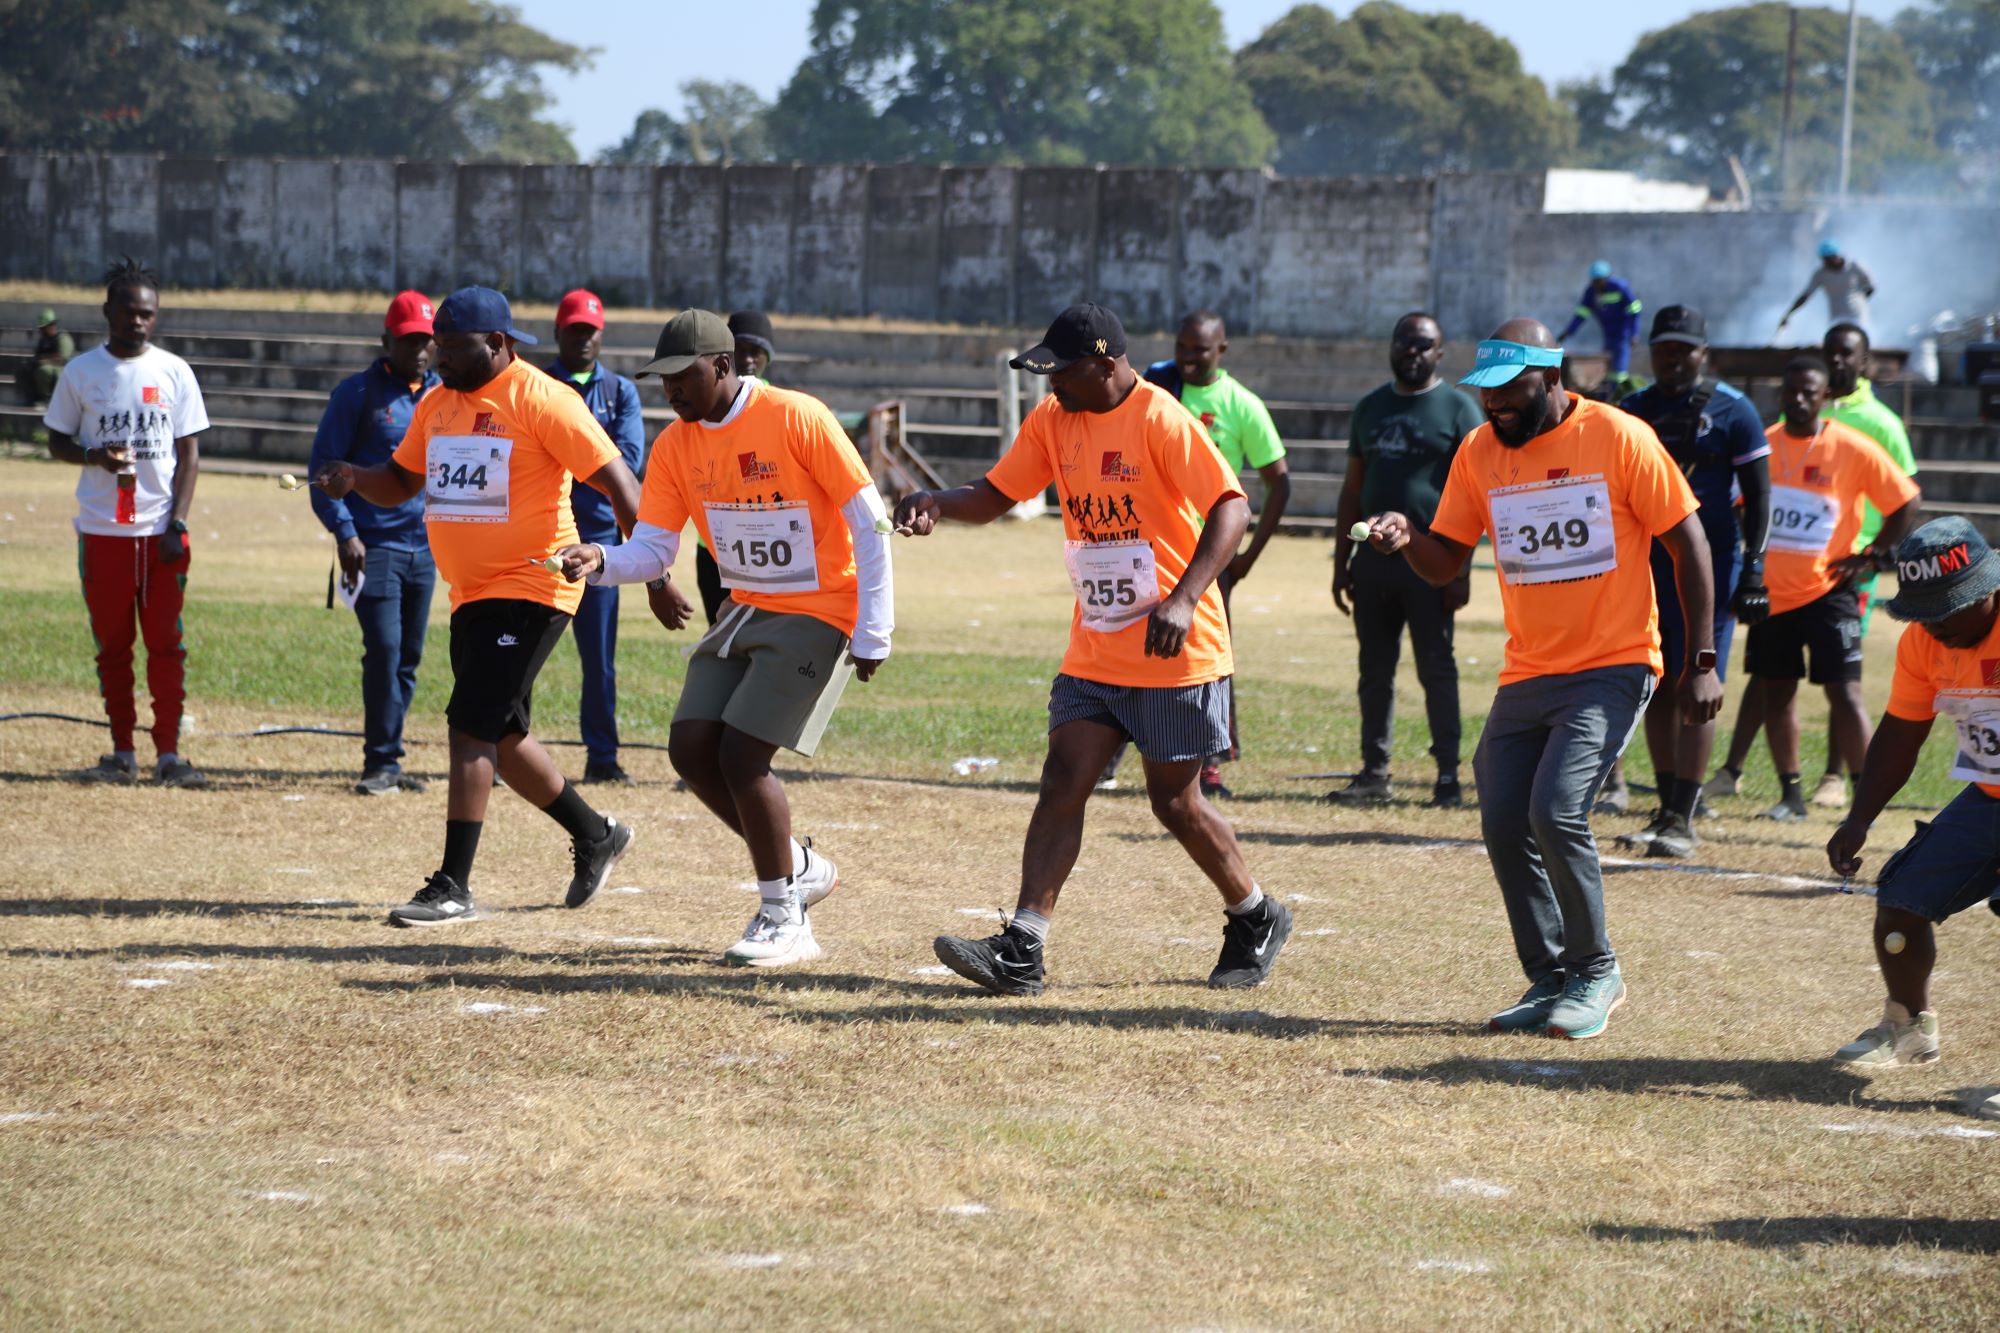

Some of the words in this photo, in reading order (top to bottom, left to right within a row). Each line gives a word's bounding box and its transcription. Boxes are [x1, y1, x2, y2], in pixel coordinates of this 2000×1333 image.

[437, 463, 488, 491] 344
[1772, 508, 1820, 532] 097
[1097, 528, 1139, 542] HEALTH
[1518, 518, 1590, 555] 349
[731, 539, 792, 567] 150
[1898, 543, 1971, 582] TOMMY
[1082, 578, 1137, 607] 255
